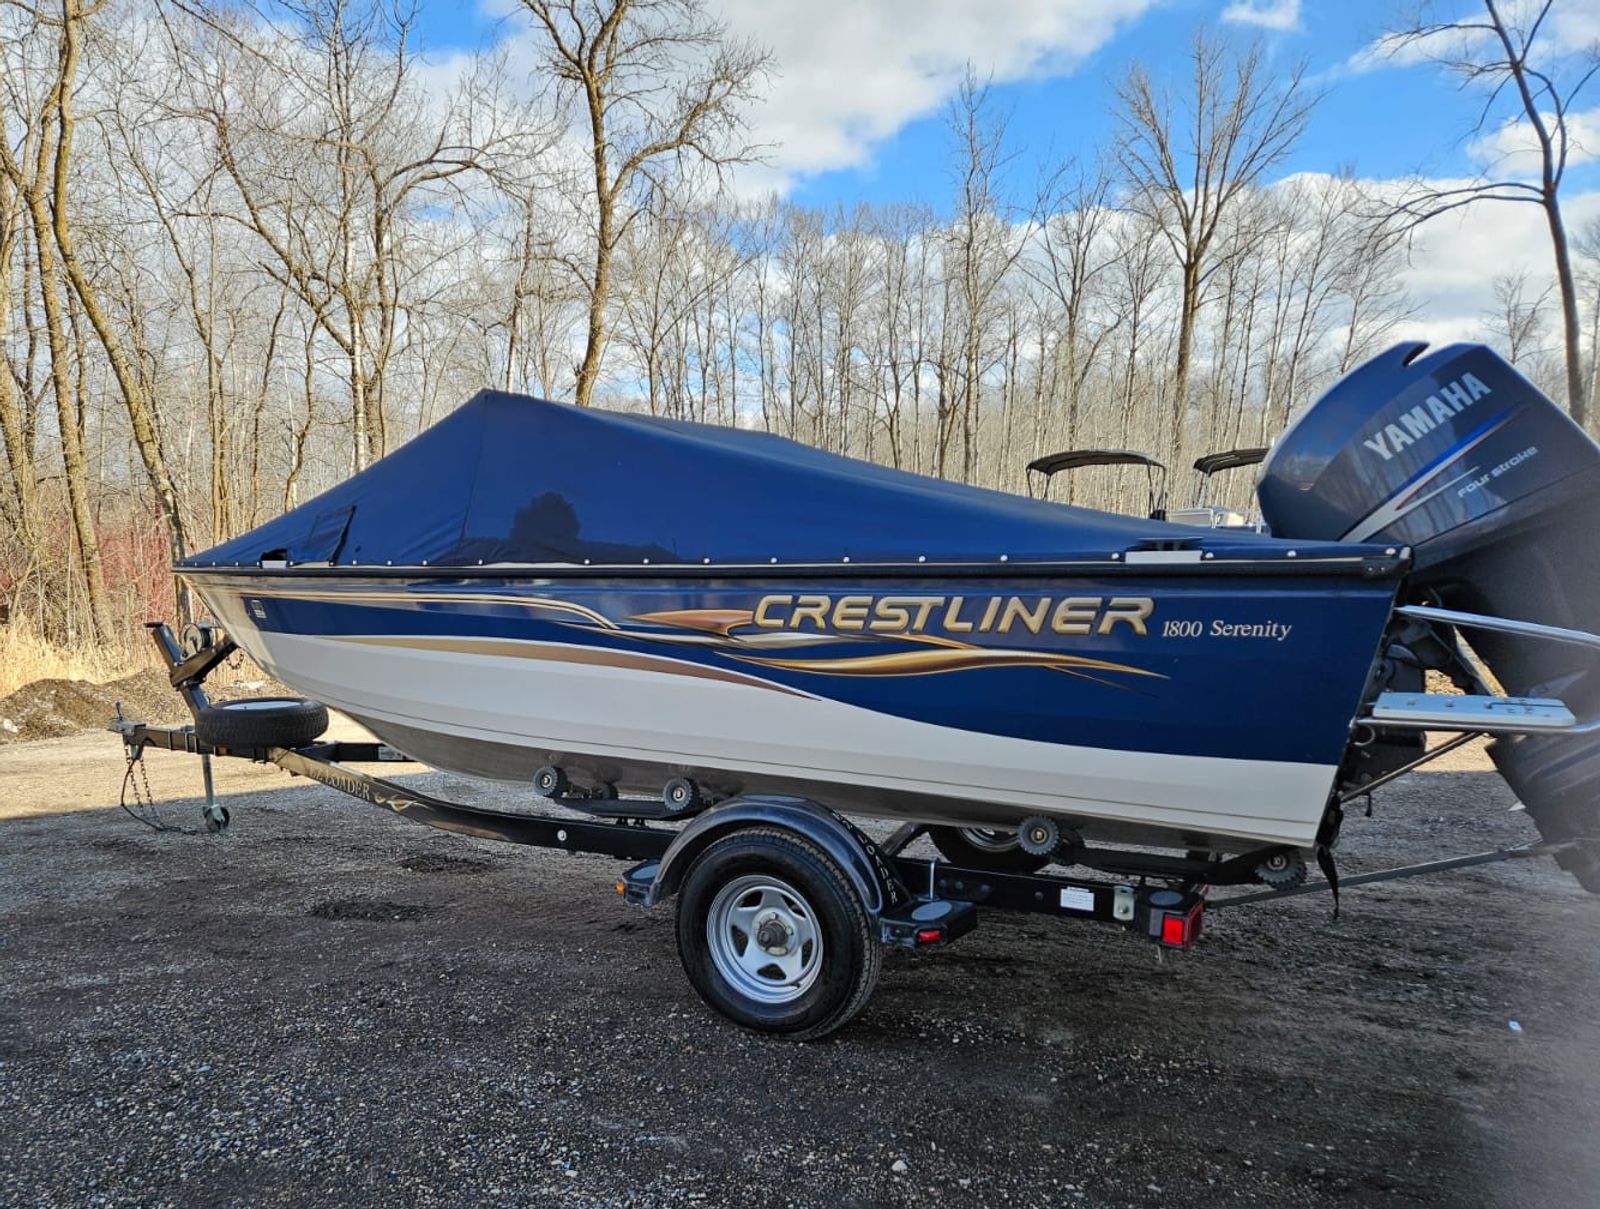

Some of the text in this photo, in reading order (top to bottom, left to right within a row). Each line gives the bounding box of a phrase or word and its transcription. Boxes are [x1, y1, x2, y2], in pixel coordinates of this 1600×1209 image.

[1363, 372, 1491, 461] YAMAHA
[754, 595, 1154, 635] CRESTLINER
[1162, 619, 1292, 641] 1800 Serenity
